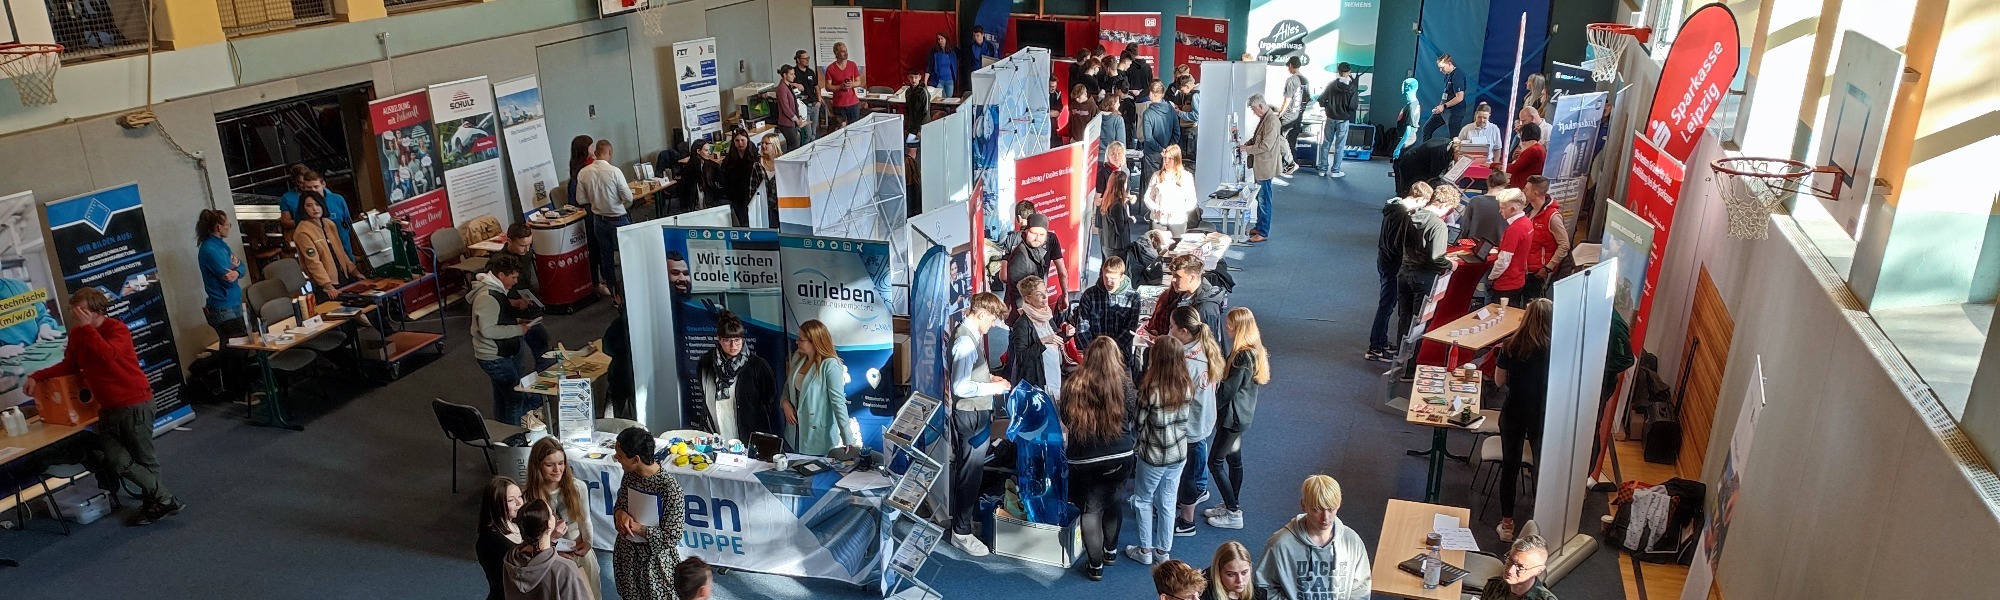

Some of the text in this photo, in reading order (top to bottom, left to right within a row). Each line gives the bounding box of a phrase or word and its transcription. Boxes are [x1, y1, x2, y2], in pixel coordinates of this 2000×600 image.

[1272, 22, 1300, 42] Alles
[1275, 55, 1307, 64] Zukft
[1671, 42, 1723, 126] Sparkasse
[450, 99, 475, 110] SCHULZ
[1681, 83, 1721, 144] Leipzig
[77, 242, 92, 254] WIR
[93, 237, 116, 250] BILDEN
[697, 252, 773, 267] Wir suchen
[693, 270, 778, 286] coole Köpfe!
[798, 280, 874, 304] airleben
[0, 308, 36, 328] (m/w/d)
[677, 530, 746, 556] UPPE
[1296, 561, 1348, 577] UNCLE
[1296, 577, 1347, 592] SAM
